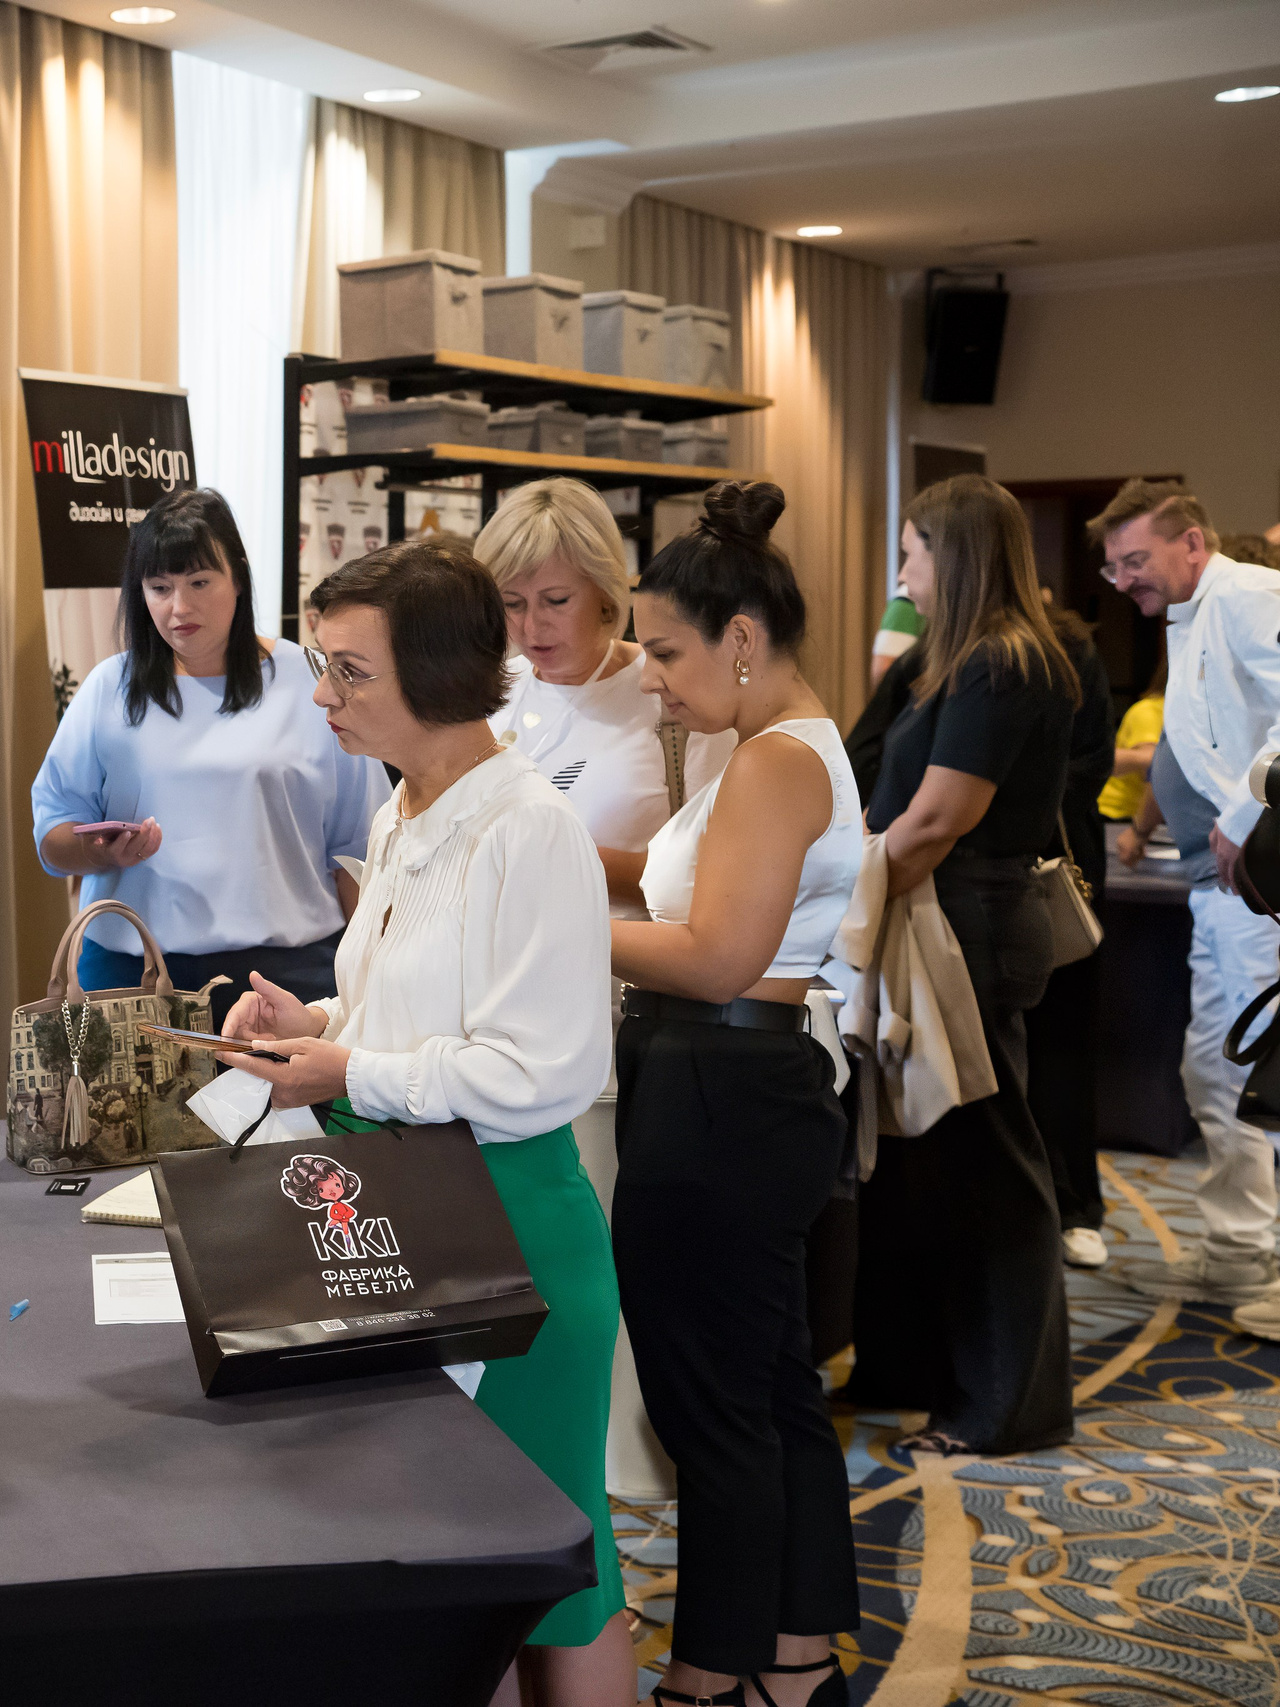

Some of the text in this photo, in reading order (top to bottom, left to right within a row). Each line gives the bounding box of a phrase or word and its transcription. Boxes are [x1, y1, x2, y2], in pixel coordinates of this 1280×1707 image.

[33, 430, 190, 493] milladesign
[113, 507, 124, 523] и
[321, 1264, 411, 1283] ФАБРИКА
[324, 1277, 415, 1299] МЕБЕЛИ
